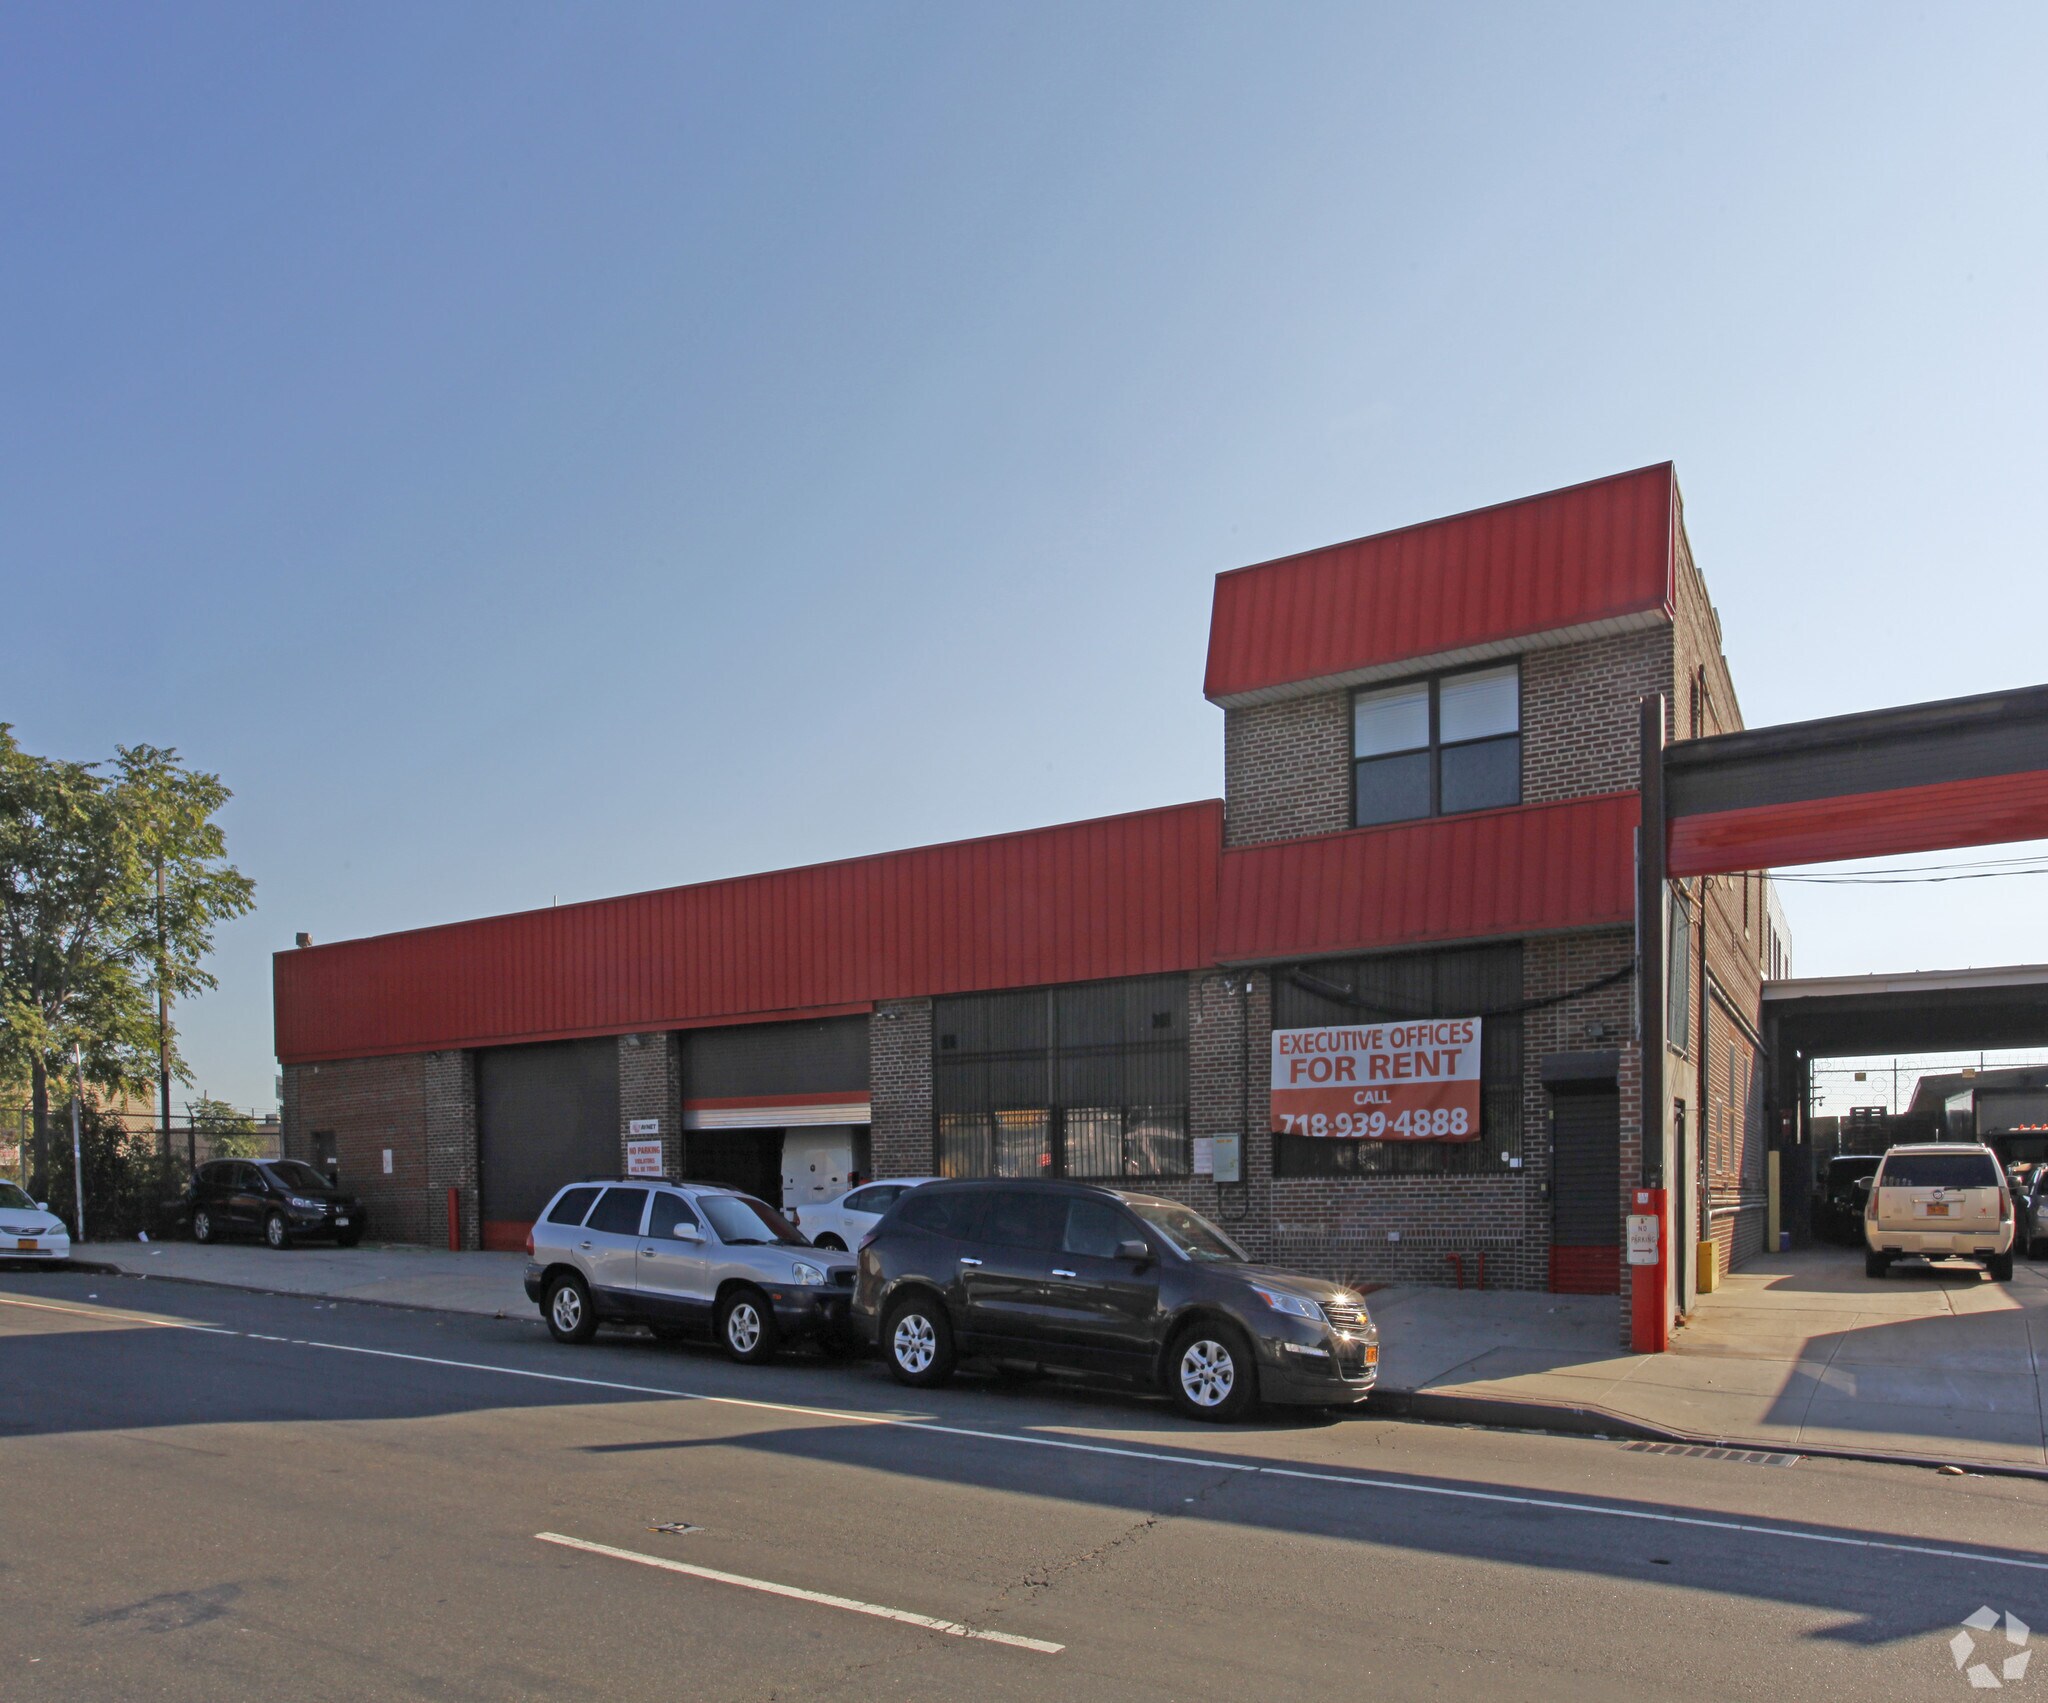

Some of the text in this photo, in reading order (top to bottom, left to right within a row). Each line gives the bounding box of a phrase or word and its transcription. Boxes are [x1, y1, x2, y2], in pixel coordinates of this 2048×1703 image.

[1279, 1021, 1474, 1055] EXECUTIVE OFFICES
[1290, 1049, 1462, 1084] FOR RENT
[1353, 1090, 1392, 1105] CALL
[638, 1146, 660, 1154] PARKING
